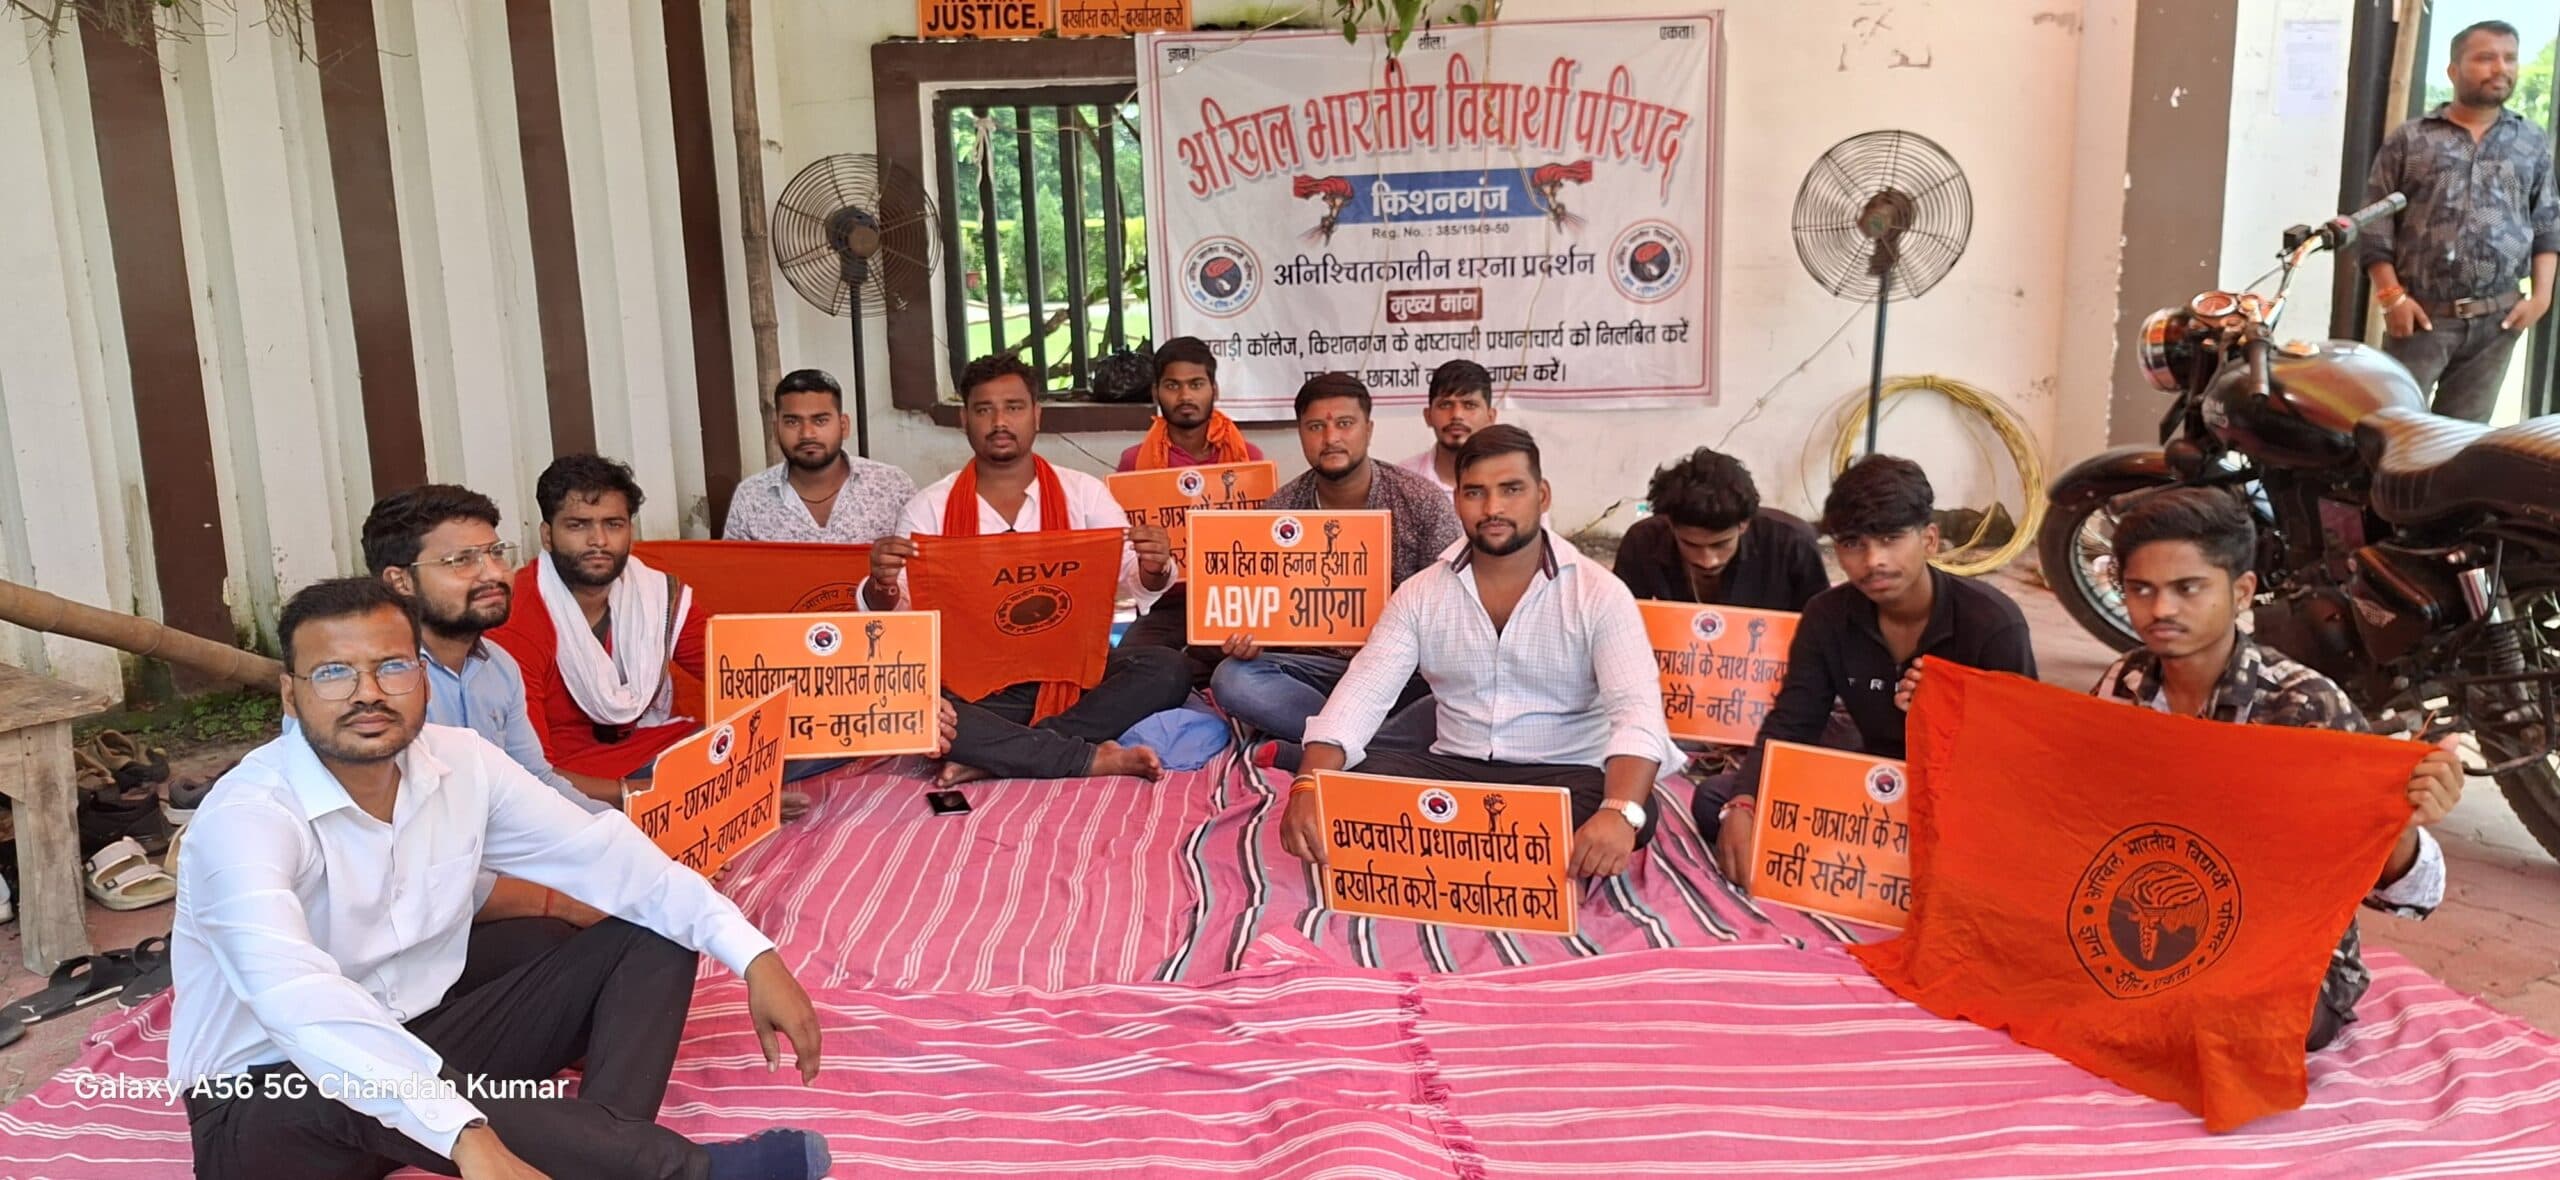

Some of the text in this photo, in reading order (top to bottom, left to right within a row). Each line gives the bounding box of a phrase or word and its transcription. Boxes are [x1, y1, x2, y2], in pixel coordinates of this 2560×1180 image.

[927, 4, 1044, 31] JUSTICE.
[1659, 25, 1695, 41] एकता!
[1177, 53, 1691, 201] अखिल भारतीय विद्यार्थी परिषद
[1371, 177, 1510, 217] किशनगंज
[1273, 250, 1451, 287] अनिश्चितकालीन
[1457, 255, 1516, 280] धरना
[1521, 245, 1596, 278] प्रदर्शन
[1389, 289, 1479, 320] मुख्य मांग
[1246, 331, 1304, 359] कॉलेज,
[1392, 327, 1410, 353] के
[1414, 326, 1480, 352] भ्रष्टाचारी
[1486, 321, 1564, 350] प्रधानाचार्य
[1569, 321, 1590, 347] को
[1661, 317, 1690, 344] करें
[992, 560, 1081, 587] ABVP
[1205, 550, 1229, 576] छात्र
[1232, 540, 1256, 578] हित
[1260, 550, 1279, 577] का
[1283, 550, 1317, 577] हनन
[1320, 550, 1349, 587] हुआ
[1353, 540, 1368, 577] तो
[1203, 585, 1368, 635] ABVP आएगा
[720, 653, 811, 699] विश्वविद्यालय
[814, 665, 870, 697] प्रशासन
[1699, 643, 1714, 677] के
[1716, 655, 1749, 681] साथ
[788, 703, 925, 746] ाद-मुर्दाबाद!
[641, 800, 672, 839] छात्र
[736, 756, 753, 789] का
[754, 736, 779, 775] पैसा
[751, 781, 775, 828] करो
[1333, 812, 1552, 866] भ्रष्टाचारी प्रधानाचार्य को
[1770, 800, 1800, 832] छात्र
[1872, 806, 1891, 848] के
[2123, 829, 2176, 856] भारतीय
[1333, 859, 1399, 906] बर्खास्त
[1523, 875, 1559, 921] करो
[1766, 842, 1913, 912] नहीं सहेंगे-नह
